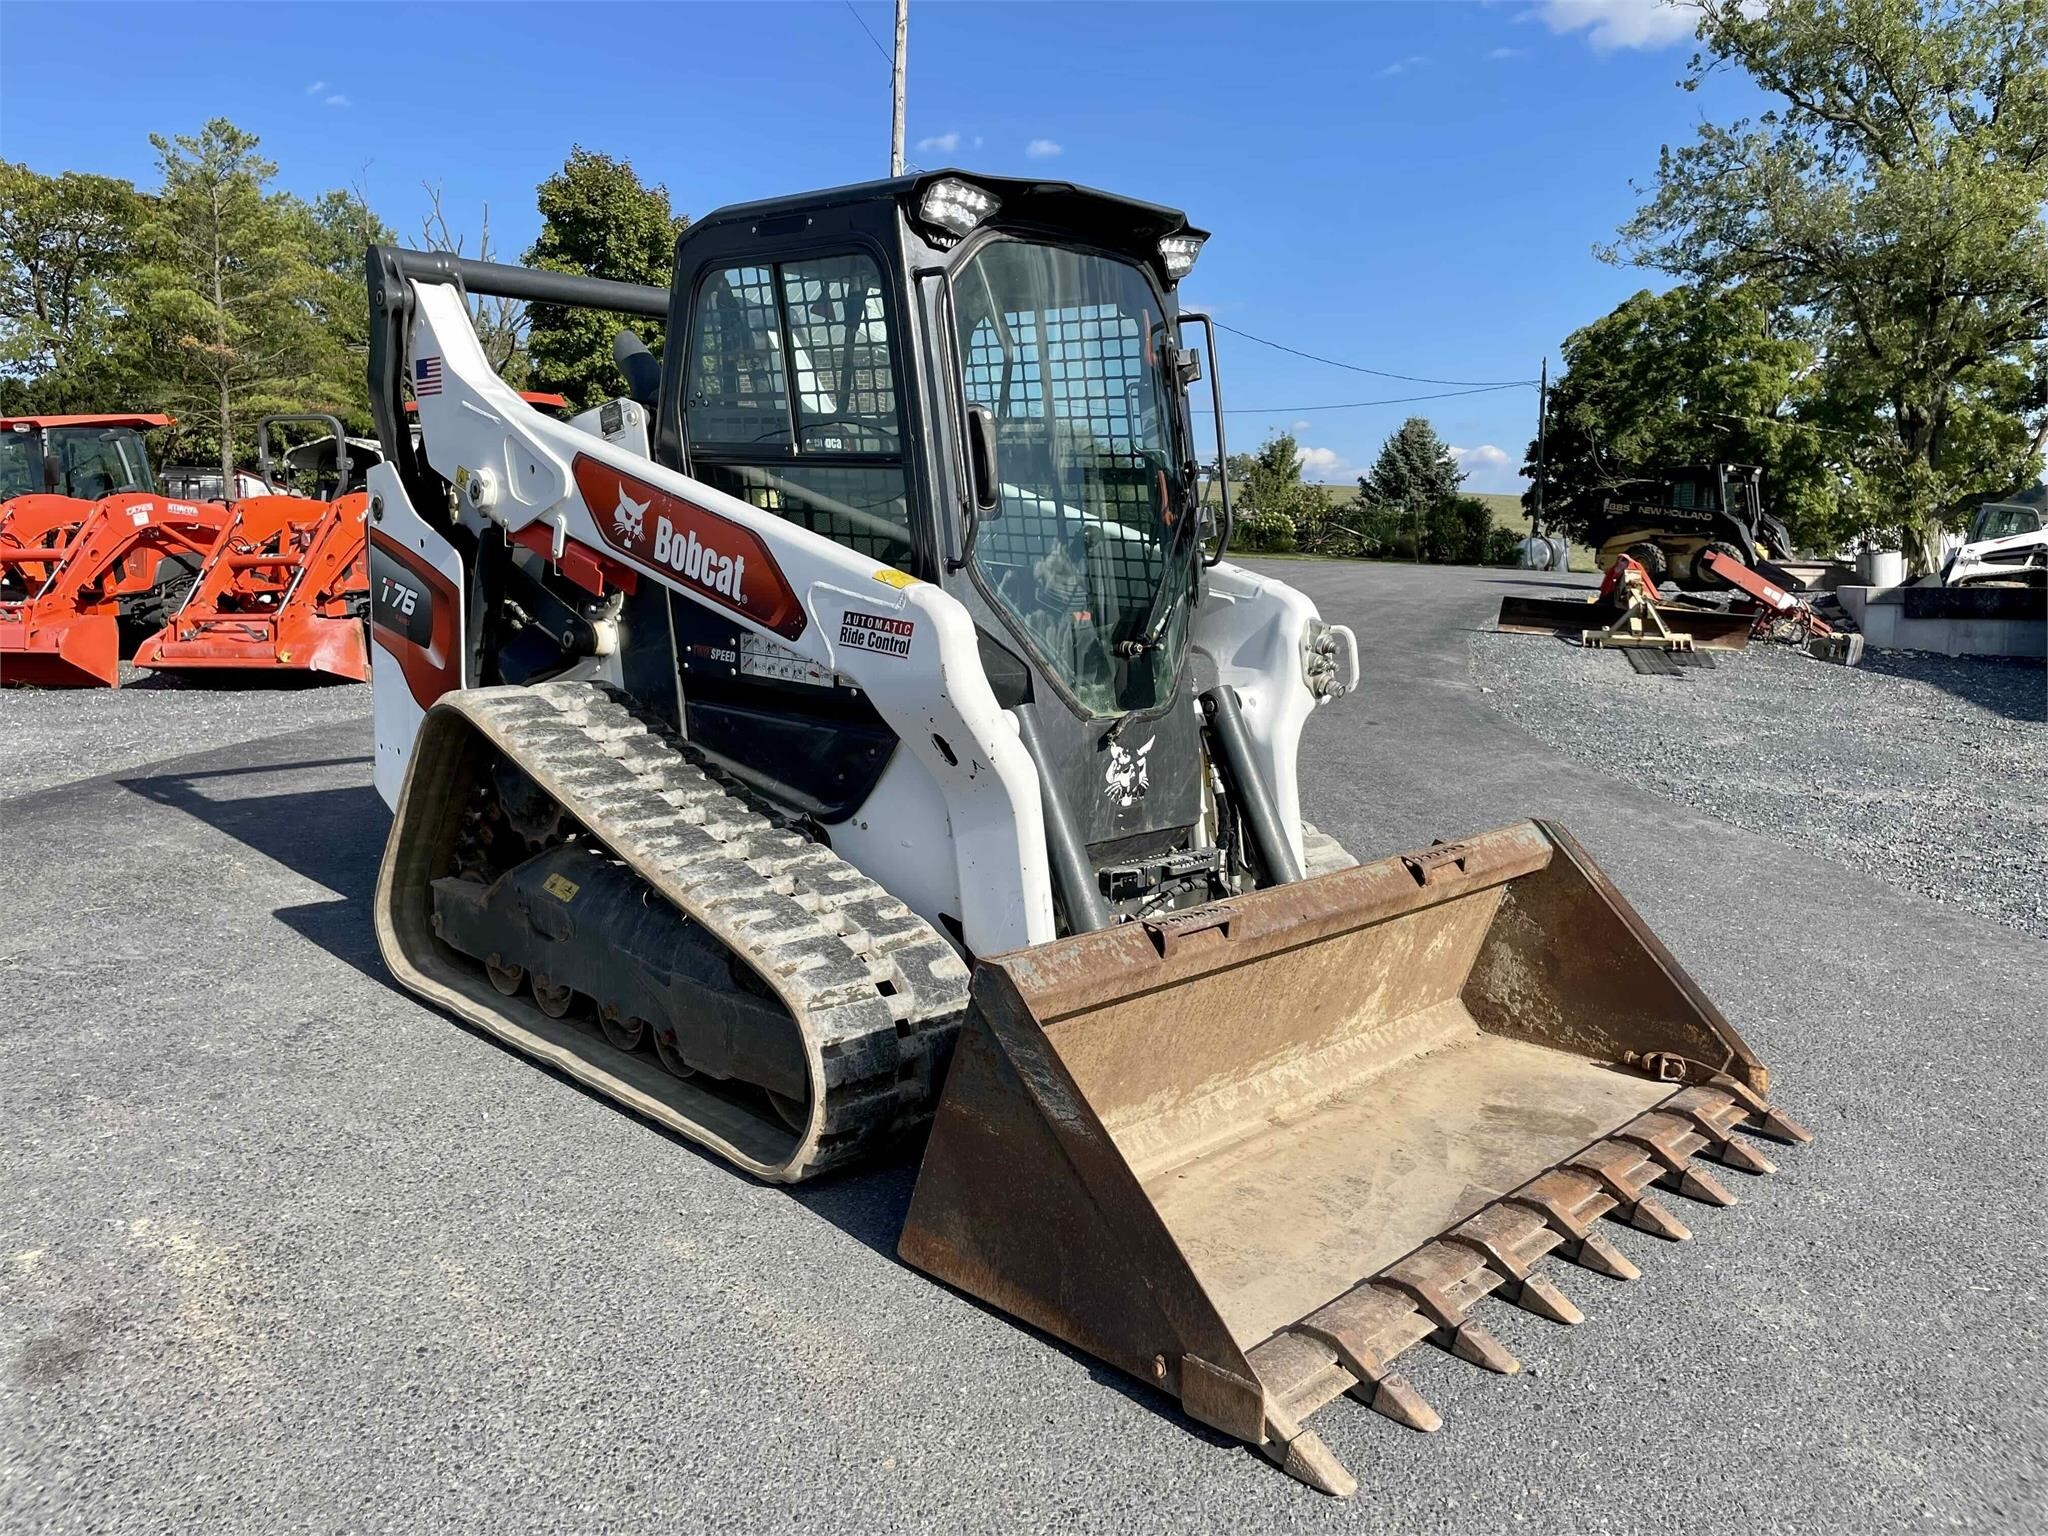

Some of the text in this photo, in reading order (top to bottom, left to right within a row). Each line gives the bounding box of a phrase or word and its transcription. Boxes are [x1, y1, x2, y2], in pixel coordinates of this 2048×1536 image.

[1638, 506, 1713, 521] NEW HOLLAND
[654, 515, 745, 602] Bobcat
[381, 577, 418, 616] T76
[845, 613, 911, 635] AUTOMATIC
[840, 626, 911, 655] Ride Control
[710, 647, 736, 663] SPEED
